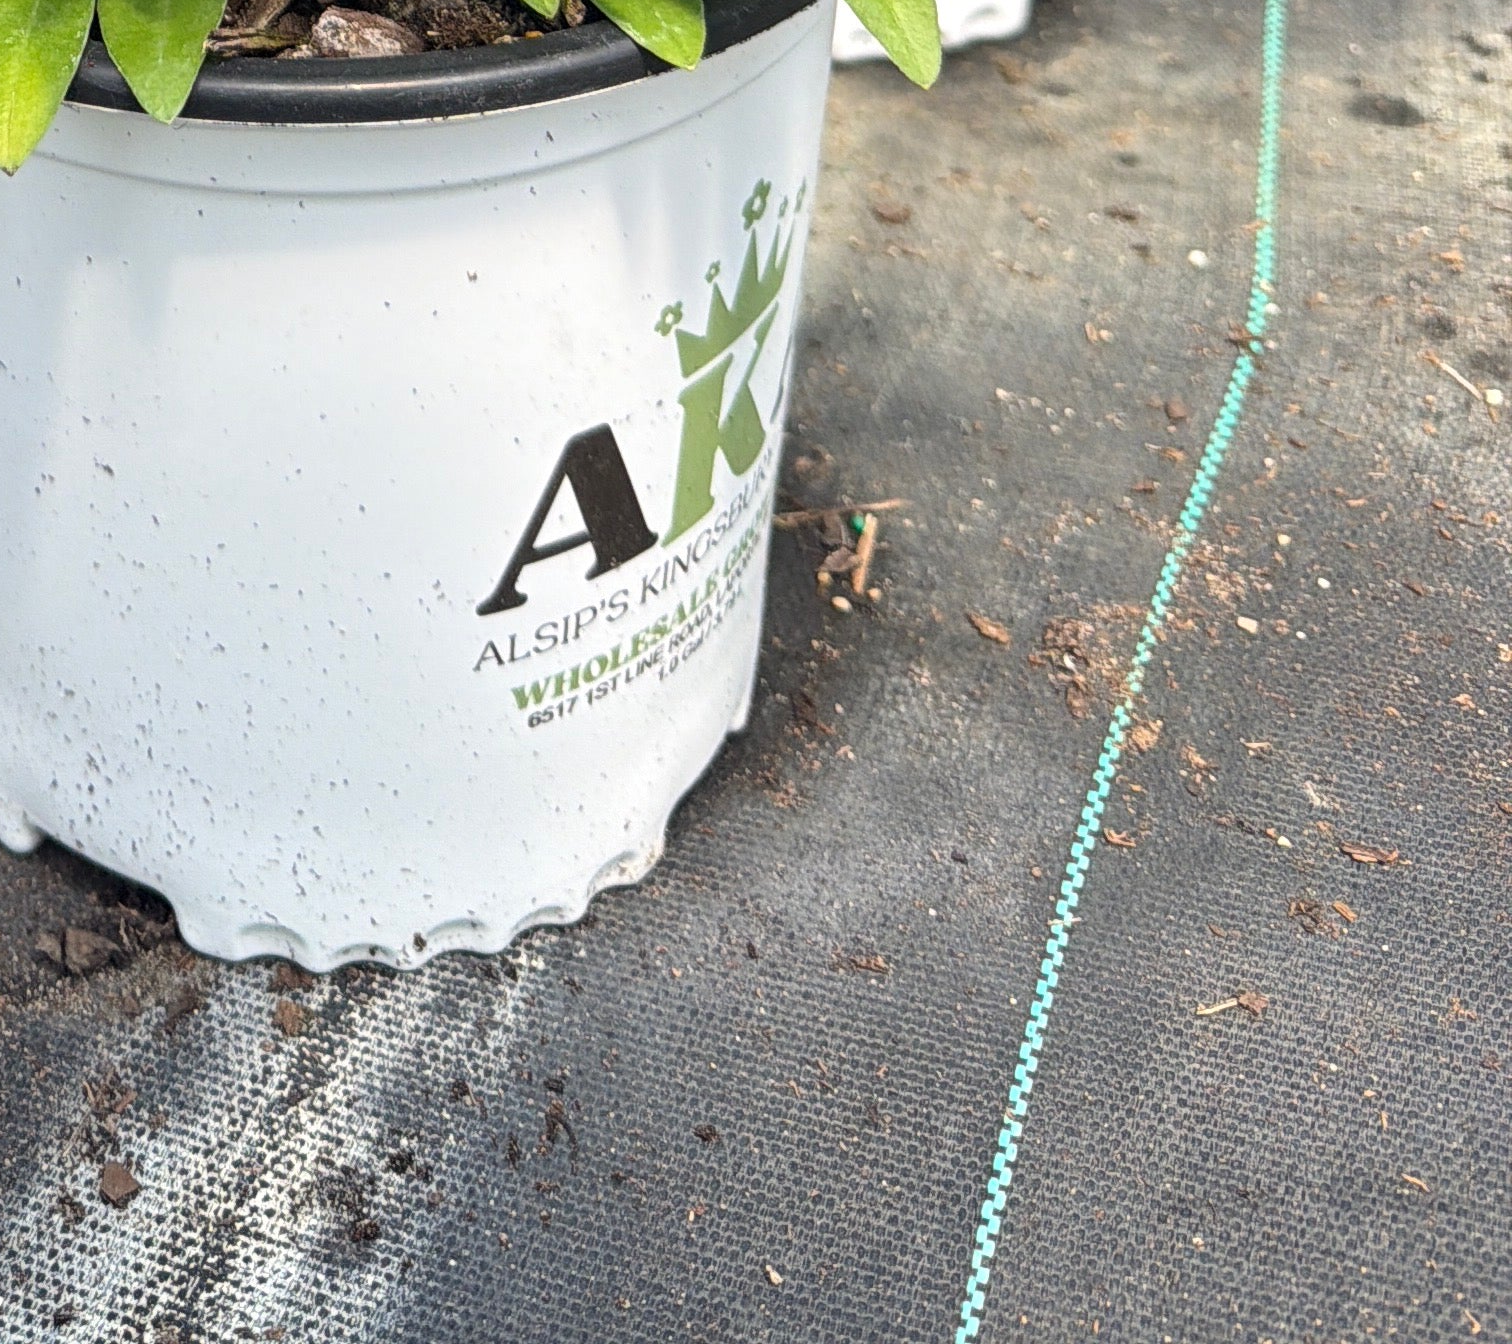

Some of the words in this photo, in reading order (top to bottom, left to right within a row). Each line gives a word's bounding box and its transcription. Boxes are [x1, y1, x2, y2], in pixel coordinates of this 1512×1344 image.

[476, 301, 792, 615] AK
[473, 588, 629, 672] ALSIP'S
[510, 567, 720, 710] WHOLESALE
[528, 694, 579, 728] 6517
[586, 672, 621, 705] 1ST
[624, 643, 665, 684] LINE
